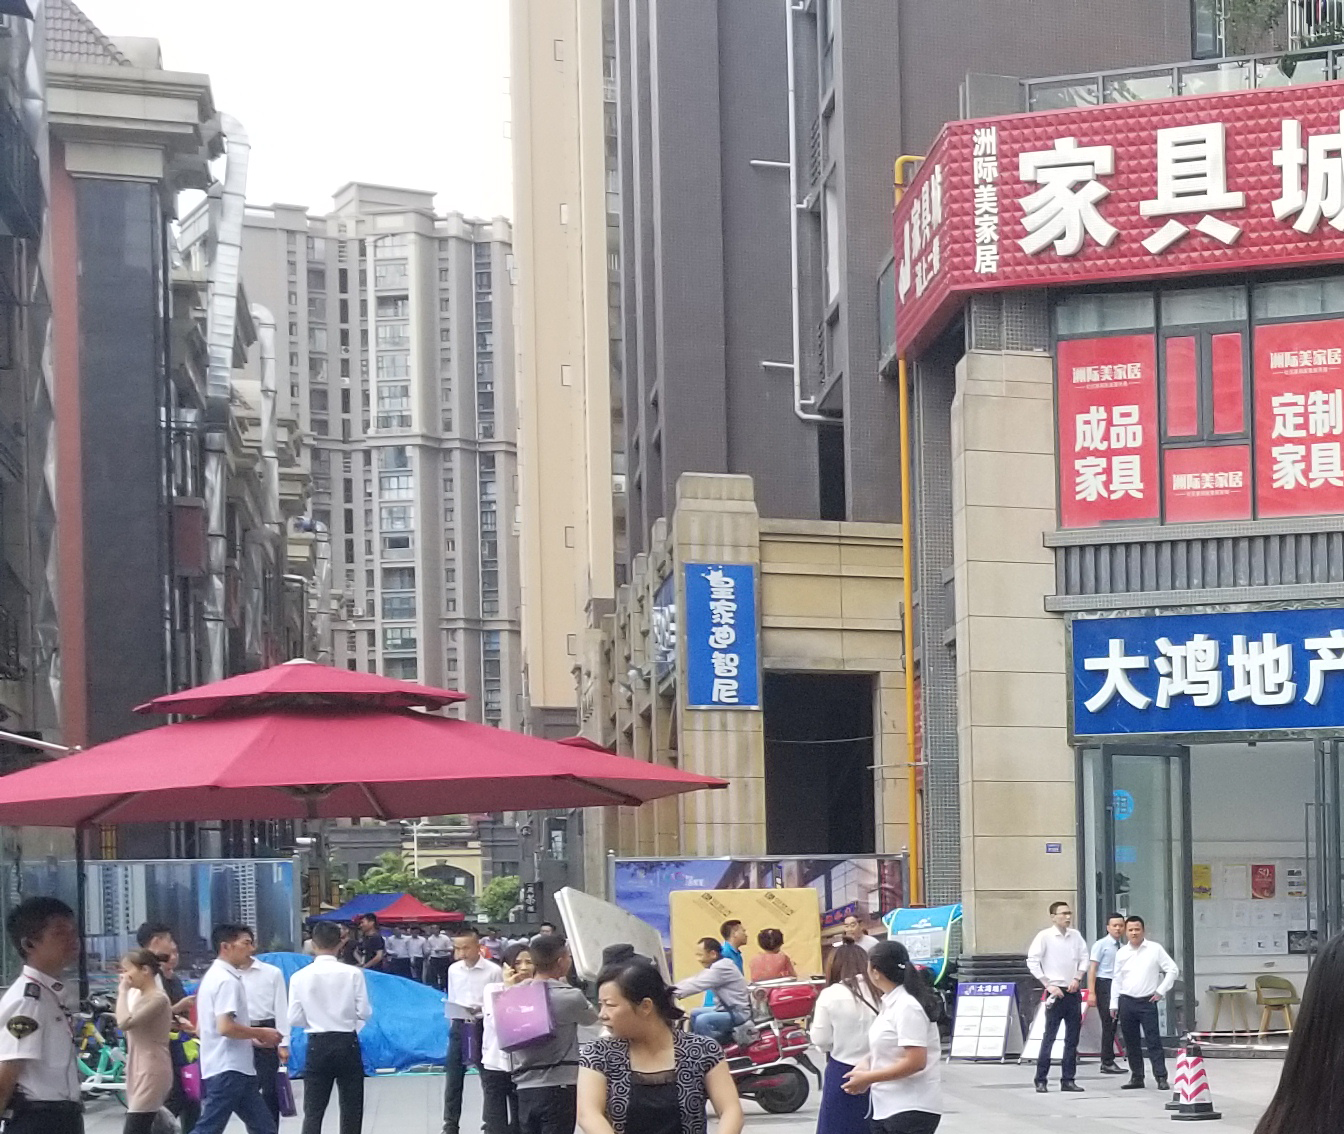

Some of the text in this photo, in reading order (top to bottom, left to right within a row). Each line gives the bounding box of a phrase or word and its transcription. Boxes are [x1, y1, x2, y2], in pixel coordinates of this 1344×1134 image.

[973, 127, 999, 274] 洲际美家居
[1072, 362, 1142, 384] 洲际美家居
[1270, 347, 1342, 369] 洲际美家居
[1074, 404, 1143, 453] 成品
[1271, 388, 1344, 439] 定制
[1074, 454, 1145, 502] 家具
[1172, 470, 1244, 491] 洲际美家居
[1271, 441, 1344, 491] 家具
[704, 566, 740, 704] 皇家迪智尼
